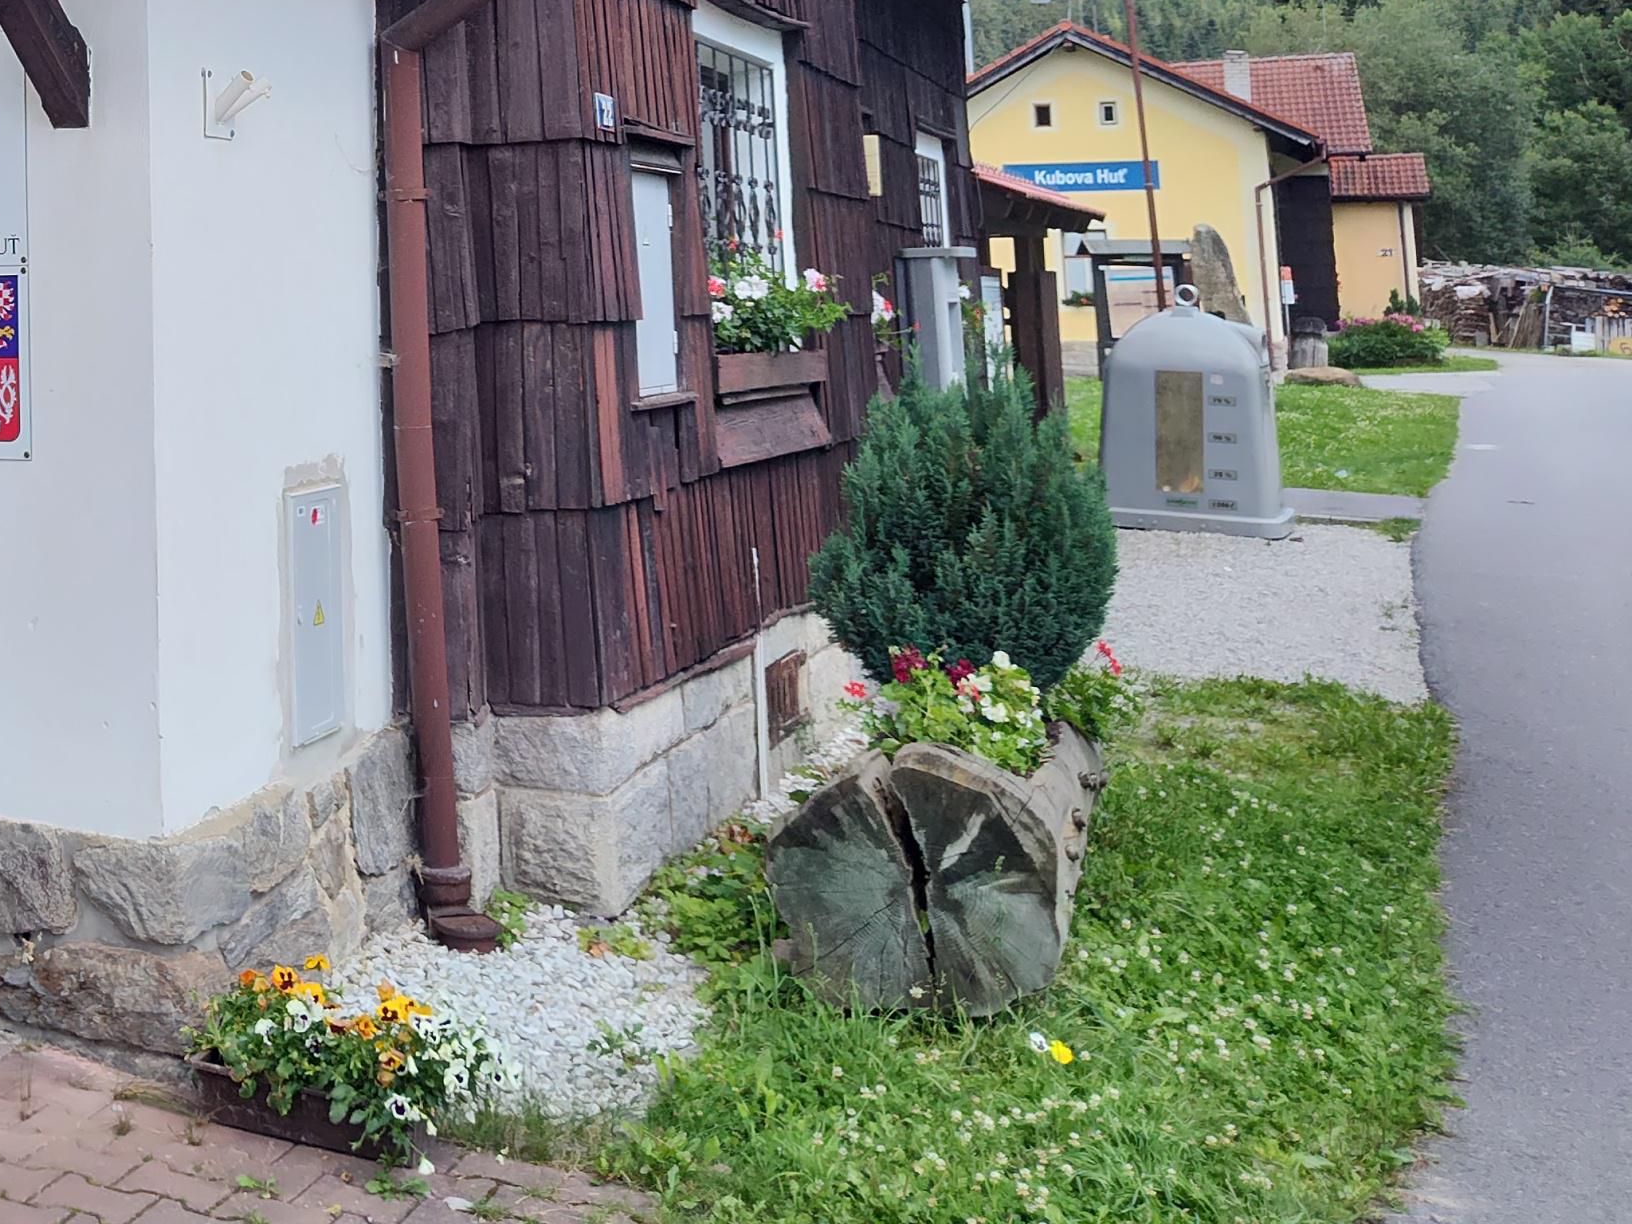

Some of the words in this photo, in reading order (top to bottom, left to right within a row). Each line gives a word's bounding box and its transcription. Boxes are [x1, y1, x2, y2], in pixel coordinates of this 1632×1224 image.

[602, 100, 614, 127] 22
[1034, 169, 1094, 186] Kubova
[1096, 167, 1128, 184] Huť
